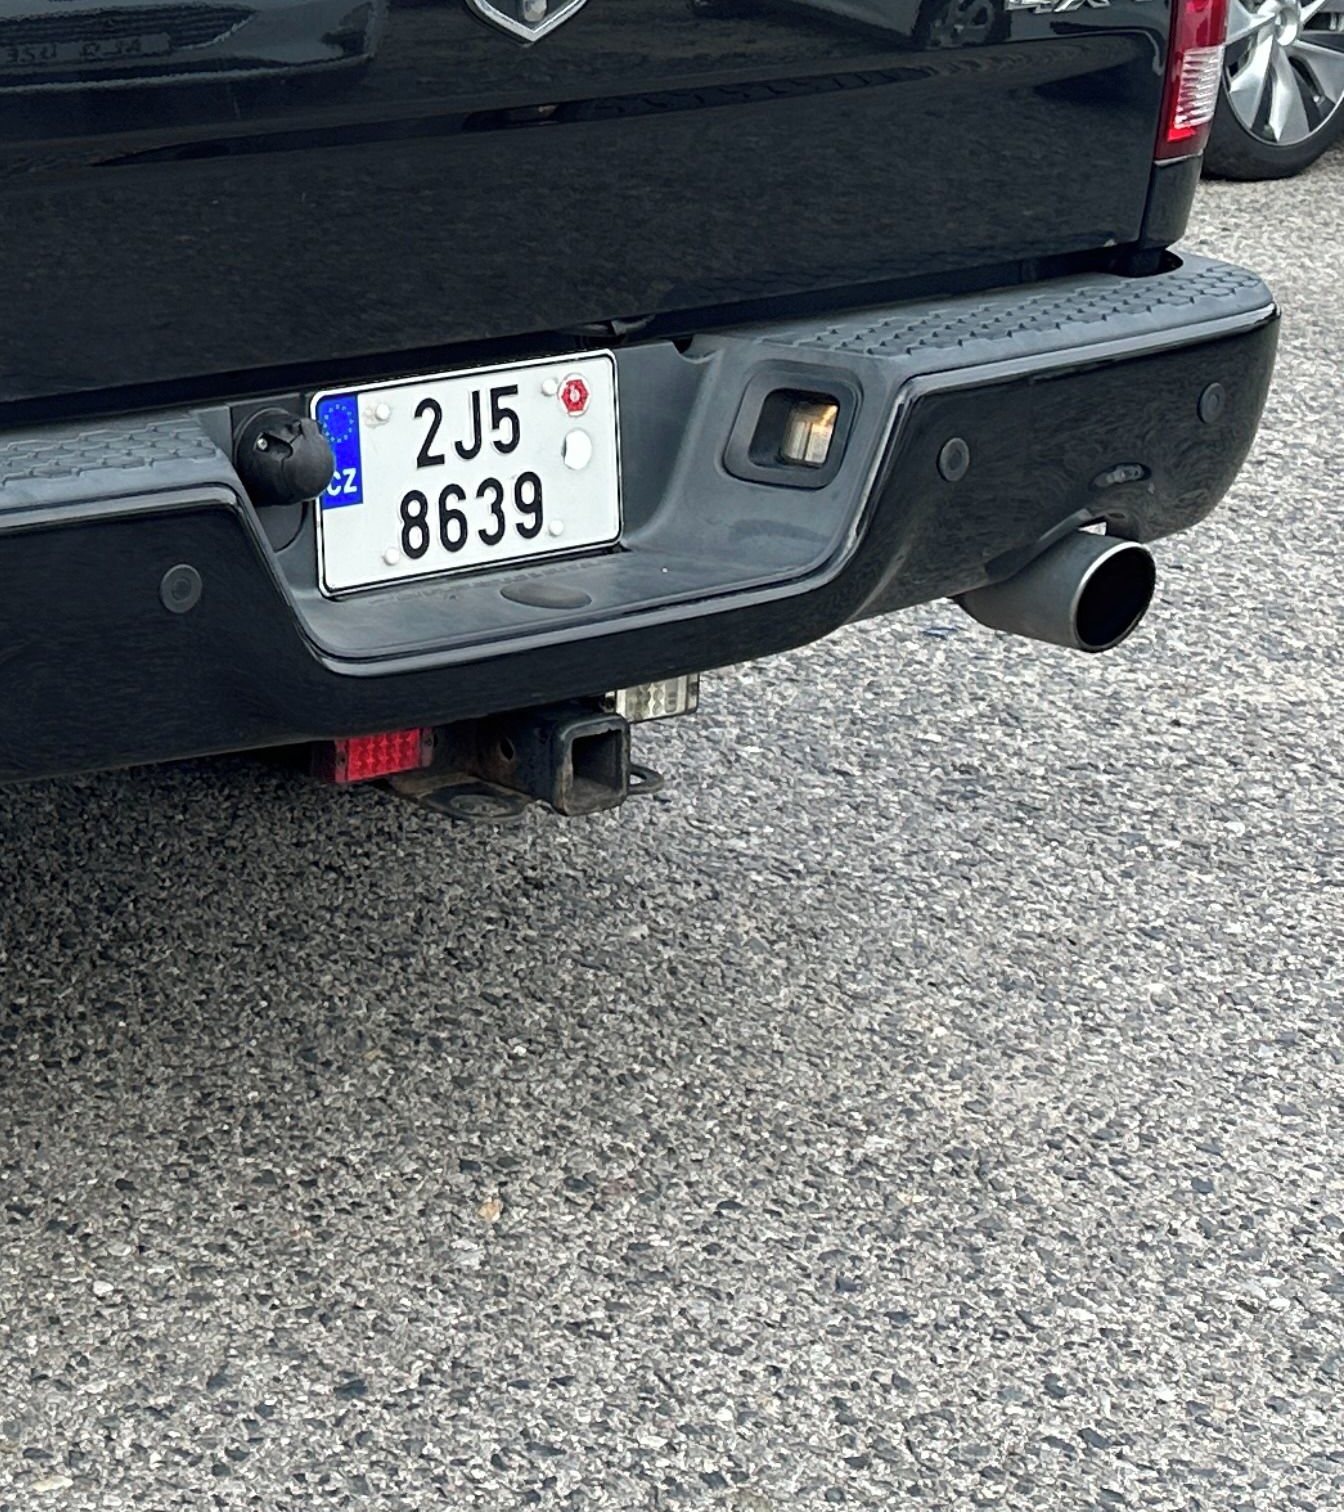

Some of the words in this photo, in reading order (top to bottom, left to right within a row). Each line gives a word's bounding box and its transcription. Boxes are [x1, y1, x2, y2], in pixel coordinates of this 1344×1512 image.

[414, 384, 521, 470] 2J5
[326, 467, 358, 496] CZ
[400, 471, 544, 560] 8639
